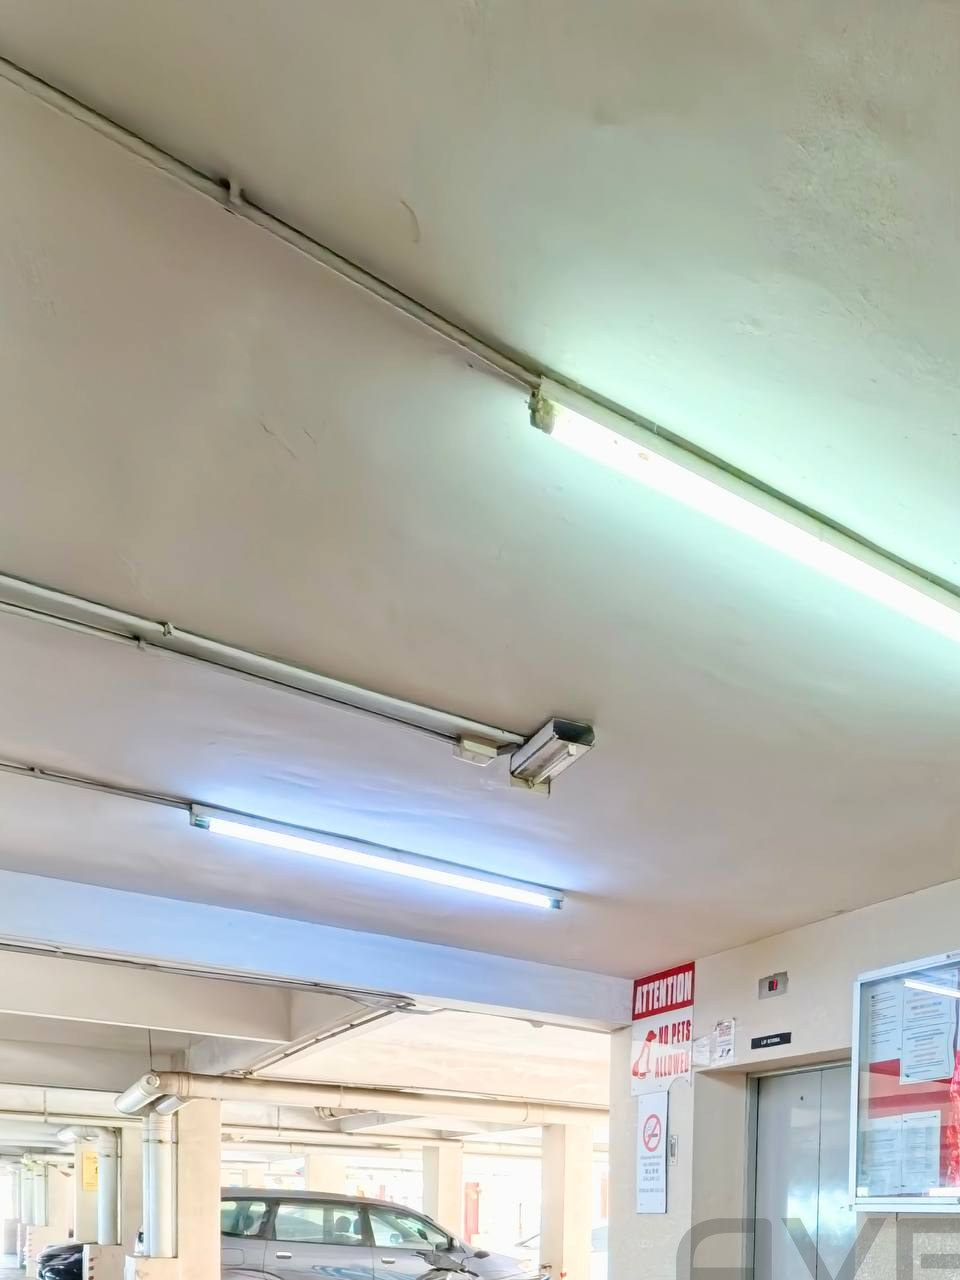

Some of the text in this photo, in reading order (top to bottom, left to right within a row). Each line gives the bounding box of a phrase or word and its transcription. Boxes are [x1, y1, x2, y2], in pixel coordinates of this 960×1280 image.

[634, 970, 693, 1015] ATTENTION
[658, 1019, 691, 1044] NO PETS
